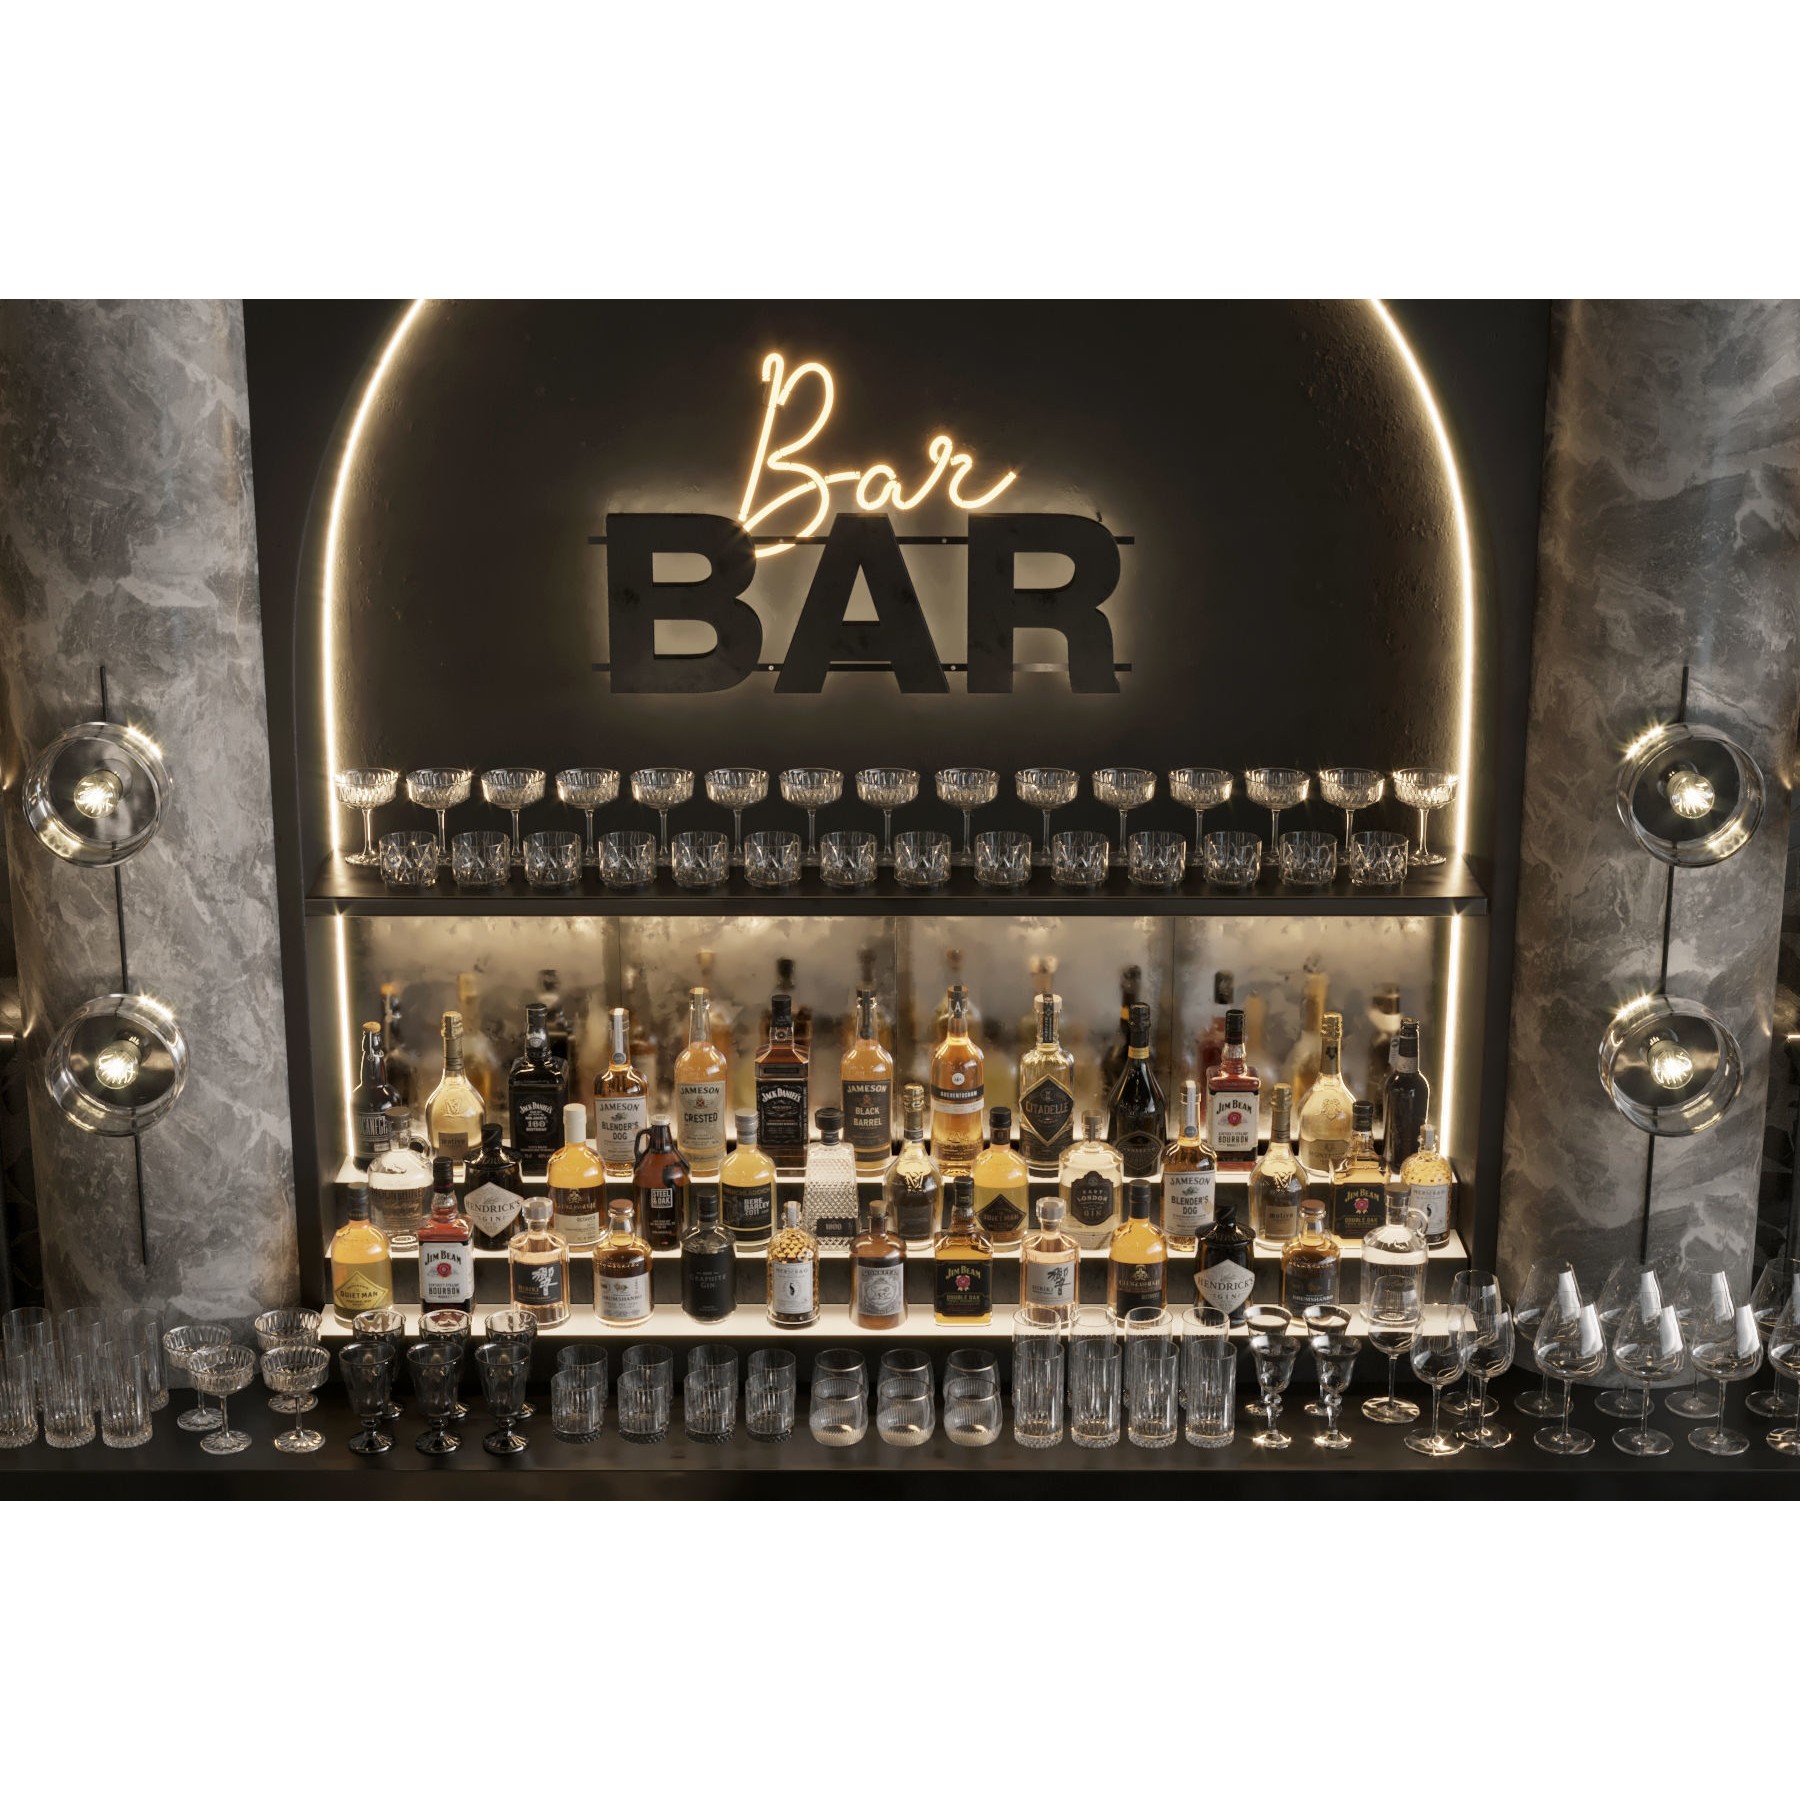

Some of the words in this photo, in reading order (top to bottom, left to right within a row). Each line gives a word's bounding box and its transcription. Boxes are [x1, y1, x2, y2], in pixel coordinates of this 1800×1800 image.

[735, 352, 1017, 559] Bar
[606, 512, 1121, 694] BAR
[680, 1086, 719, 1095] JAMESON
[847, 1085, 887, 1093] JAMESON
[761, 1090, 777, 1103] JACK
[777, 1087, 802, 1103] DANIEL'S
[519, 1103, 532, 1114] JACK
[599, 1102, 640, 1112] JAMESON
[855, 1107, 880, 1116] BLACK
[1025, 1101, 1070, 1114] CITADELLE
[1216, 1102, 1231, 1115] JIM
[1232, 1100, 1252, 1114] BEAM
[684, 1112, 718, 1124] CRESTED
[853, 1118, 883, 1127] BARREL
[601, 1121, 639, 1131] BLENDER'S
[612, 1132, 628, 1140] DOG
[1170, 1176, 1210, 1186] JAMESON
[652, 1190, 670, 1198] STEEL
[1344, 1190, 1360, 1202] JIM
[1360, 1188, 1380, 1202] BEAM
[744, 1200, 770, 1211] BARLEY
[1171, 1196, 1209, 1206] BLENDER'S
[465, 1200, 520, 1213] HENDRICK'S
[1182, 1206, 1198, 1215] DOG
[424, 1252, 439, 1266] JIM
[440, 1250, 462, 1265] BEAM
[945, 1268, 960, 1280] JIM
[960, 1265, 981, 1280] BEAM
[340, 1291, 360, 1300] QUIET
[361, 1291, 378, 1299] MAN
[428, 1287, 461, 1295] BOURBON
